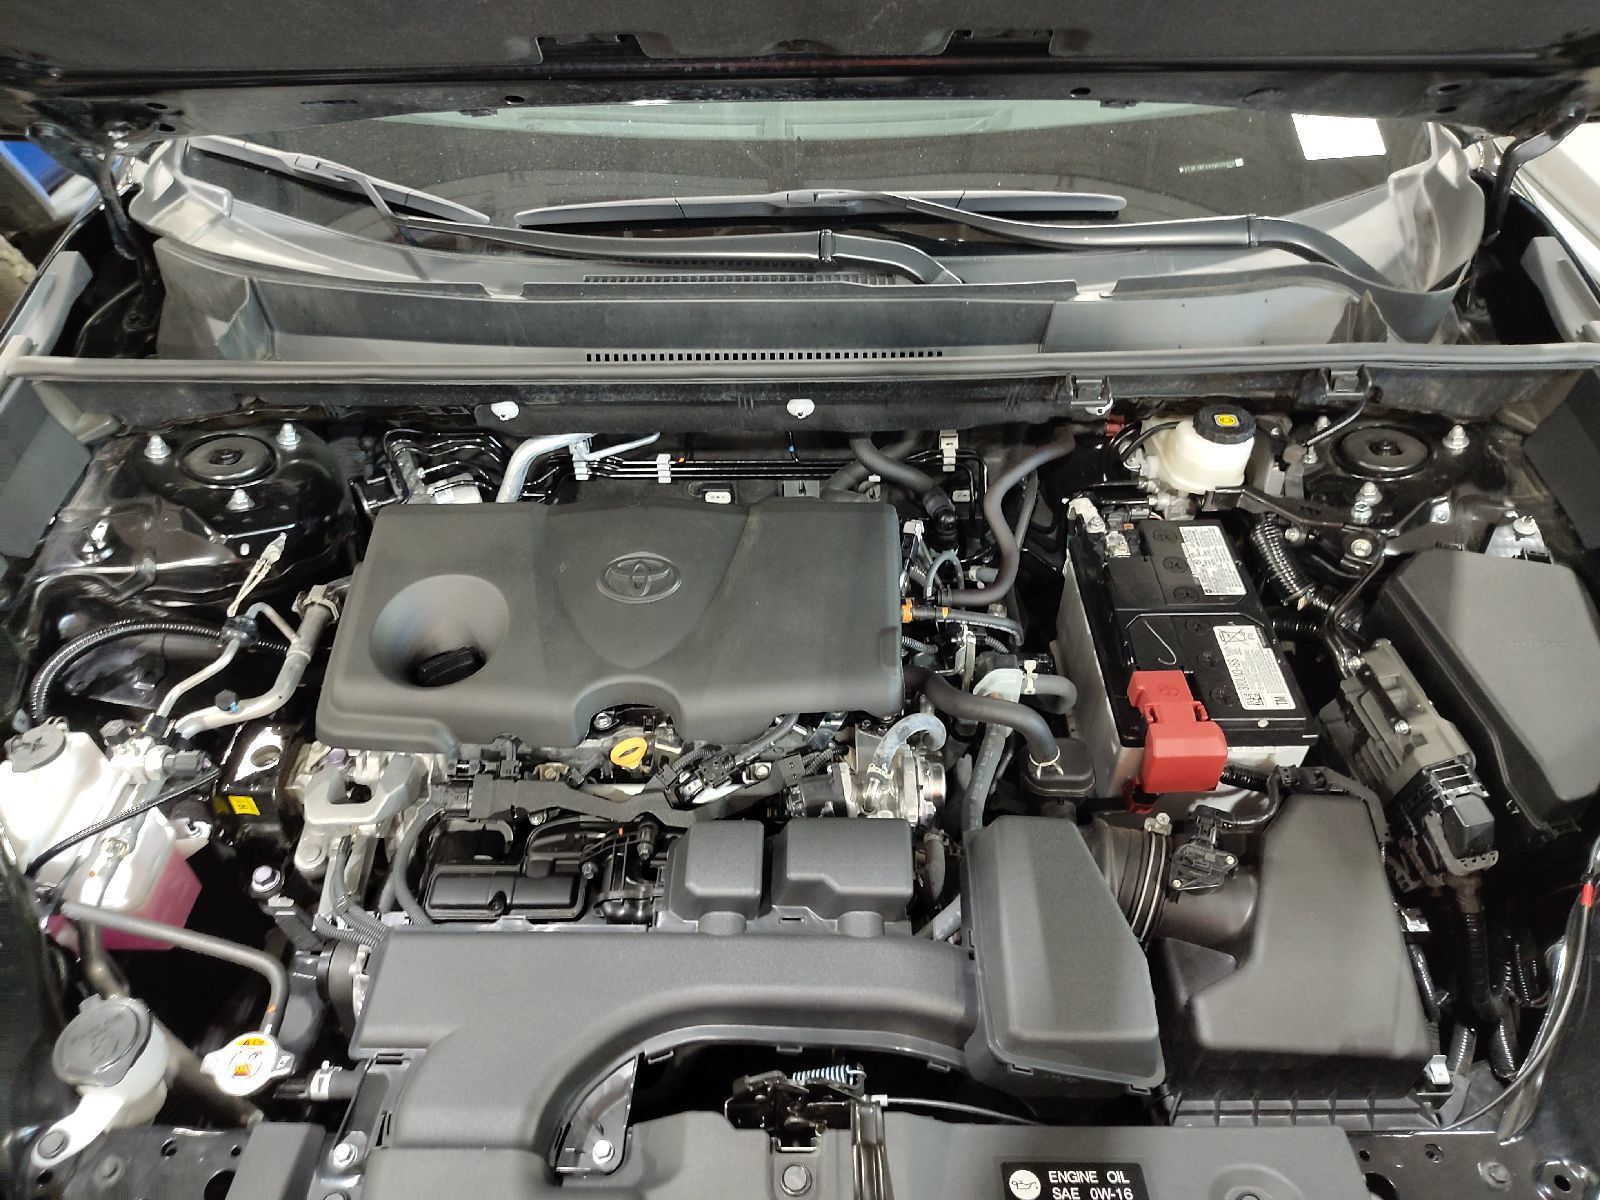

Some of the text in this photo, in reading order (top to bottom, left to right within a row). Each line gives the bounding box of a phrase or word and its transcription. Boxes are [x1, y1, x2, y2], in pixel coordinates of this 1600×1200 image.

[1048, 1170, 1130, 1184] ENGINE OIL
[1052, 1187, 1133, 1200] SAE 0W-16
